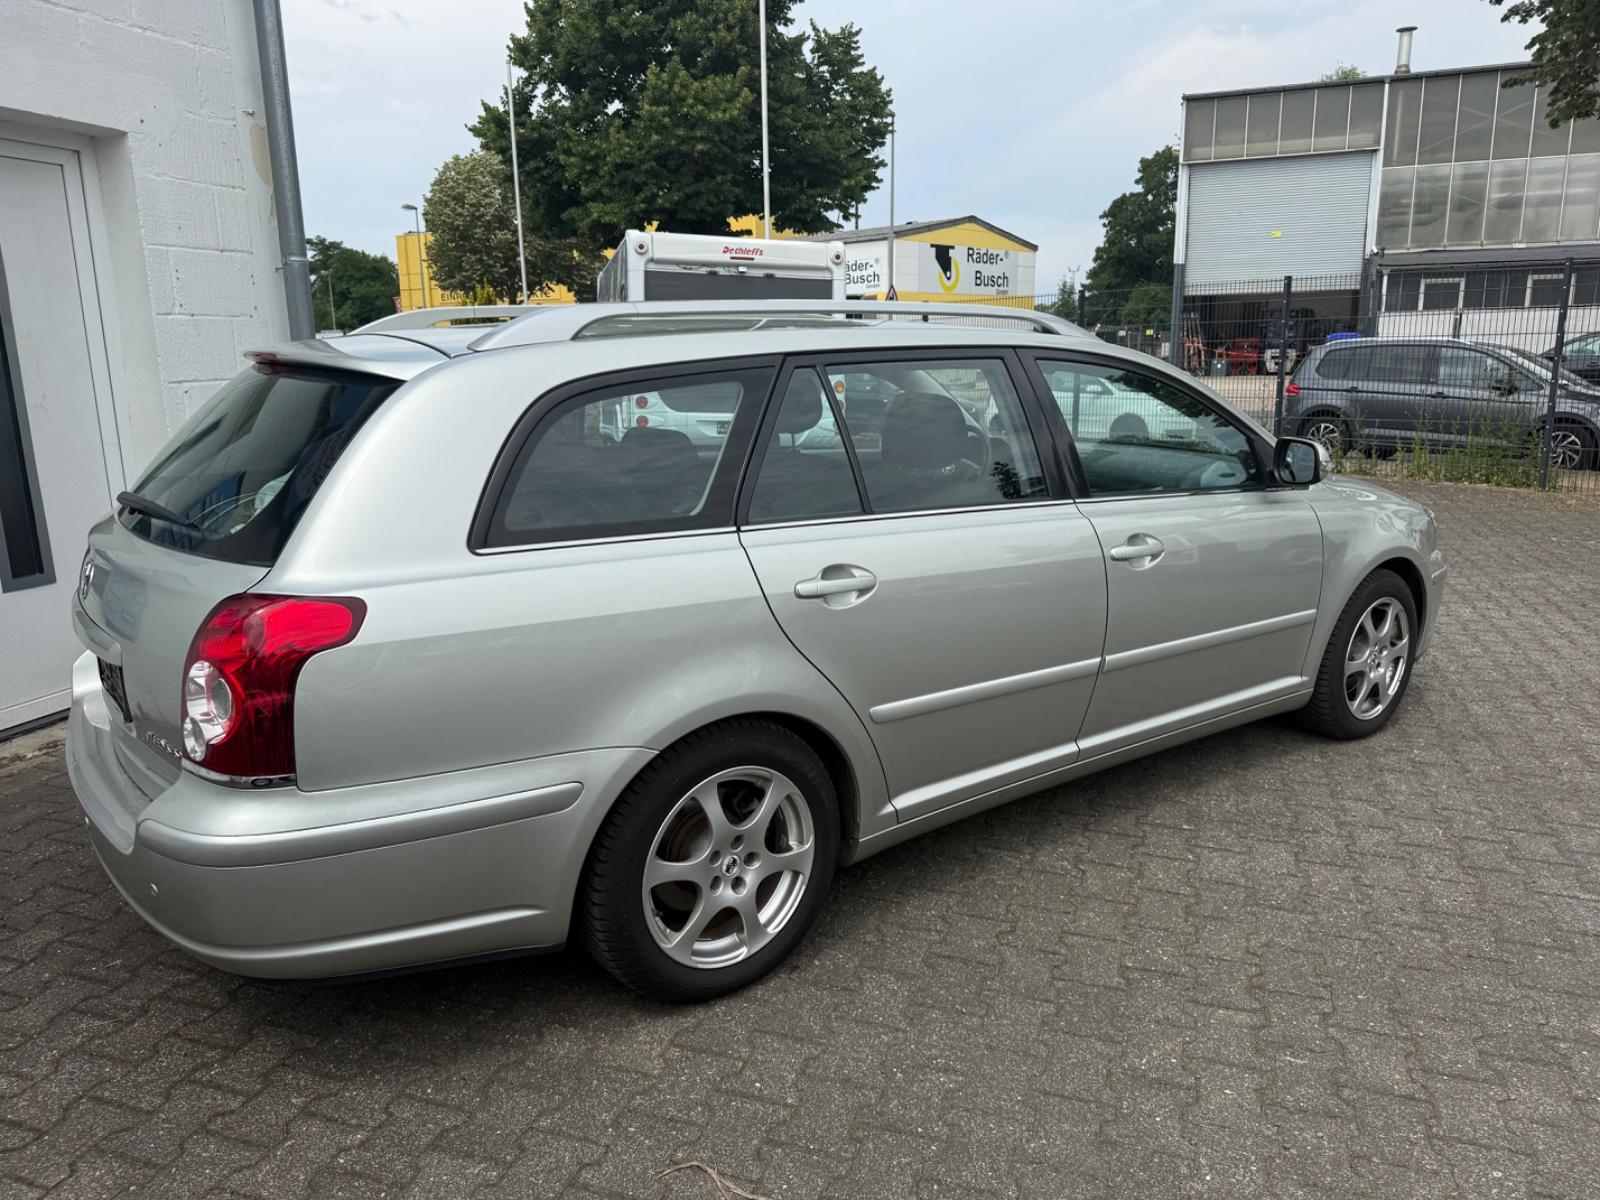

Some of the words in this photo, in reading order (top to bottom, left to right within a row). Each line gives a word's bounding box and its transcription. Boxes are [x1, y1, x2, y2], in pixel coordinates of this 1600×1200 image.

[722, 246, 763, 256] Dethleffs
[967, 247, 1003, 265] Räder-
[846, 271, 880, 285] Busch
[975, 270, 1009, 288] Busch
